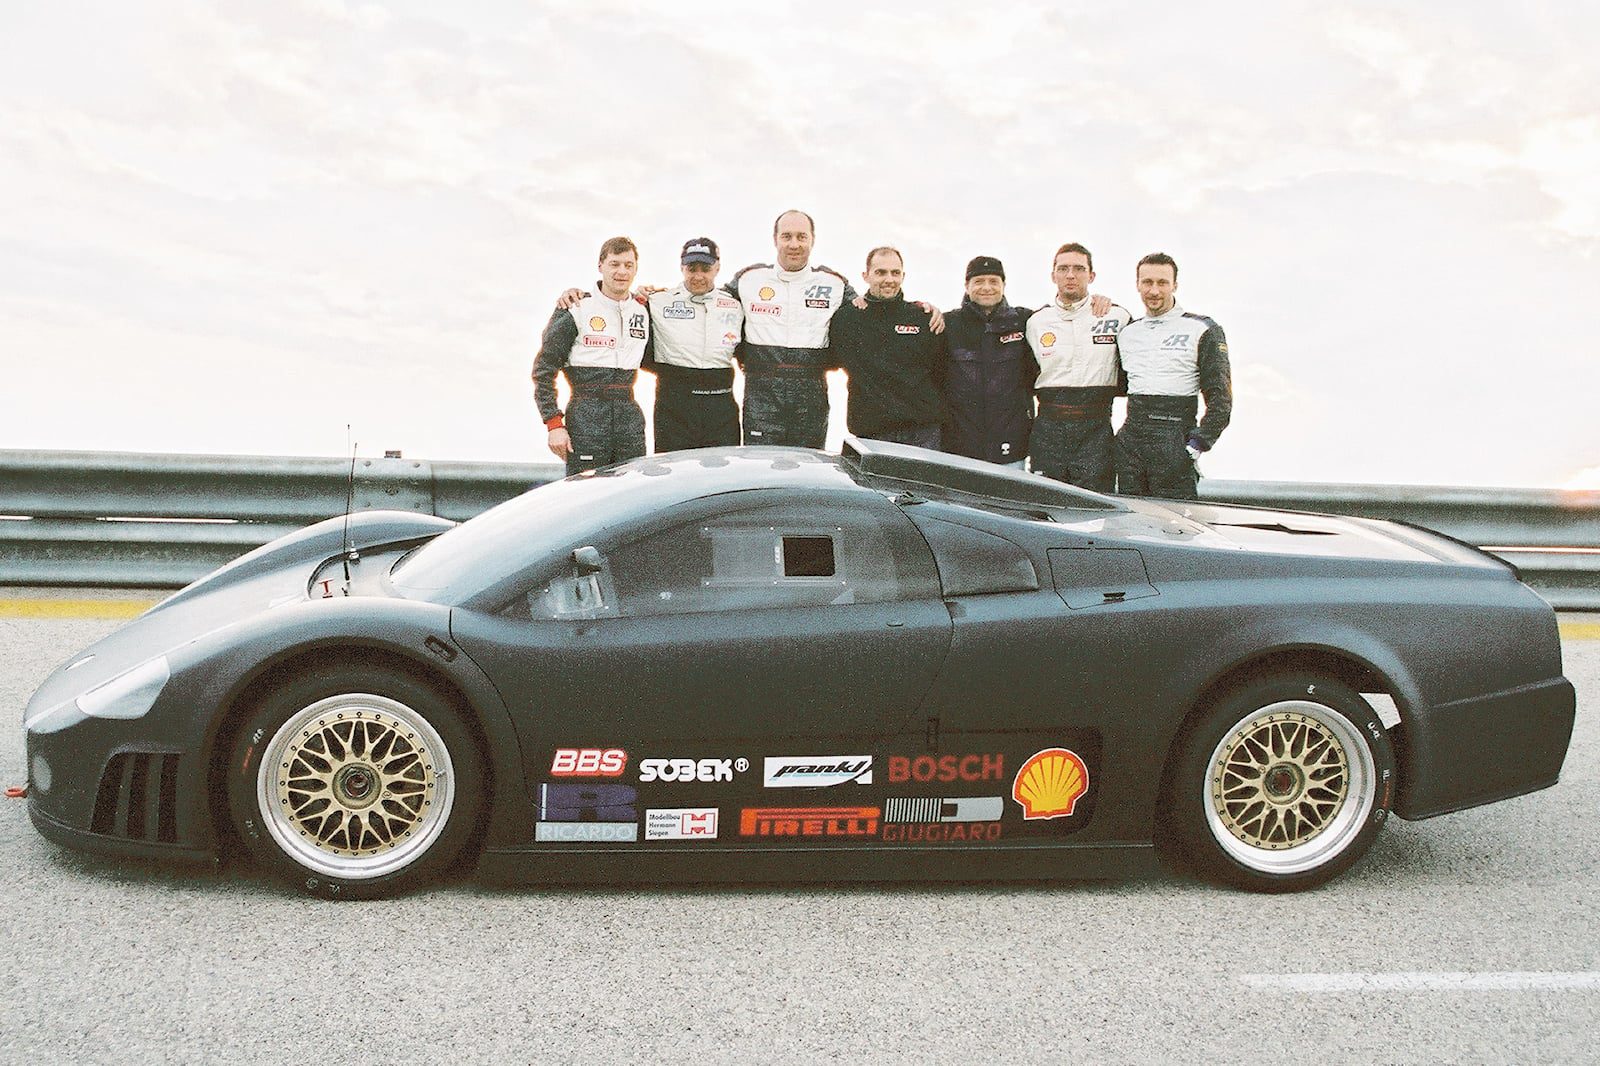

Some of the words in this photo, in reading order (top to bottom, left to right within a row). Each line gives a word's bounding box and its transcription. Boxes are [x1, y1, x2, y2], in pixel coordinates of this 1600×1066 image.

[551, 749, 627, 776] BBS
[888, 754, 1004, 783] BOSCH
[648, 813, 681, 821] Modellbau
[740, 807, 880, 837] PIRELLI
[541, 824, 634, 840] RICARDO
[648, 829, 669, 838] Siegen
[881, 822, 1002, 842] GIUGIARO
